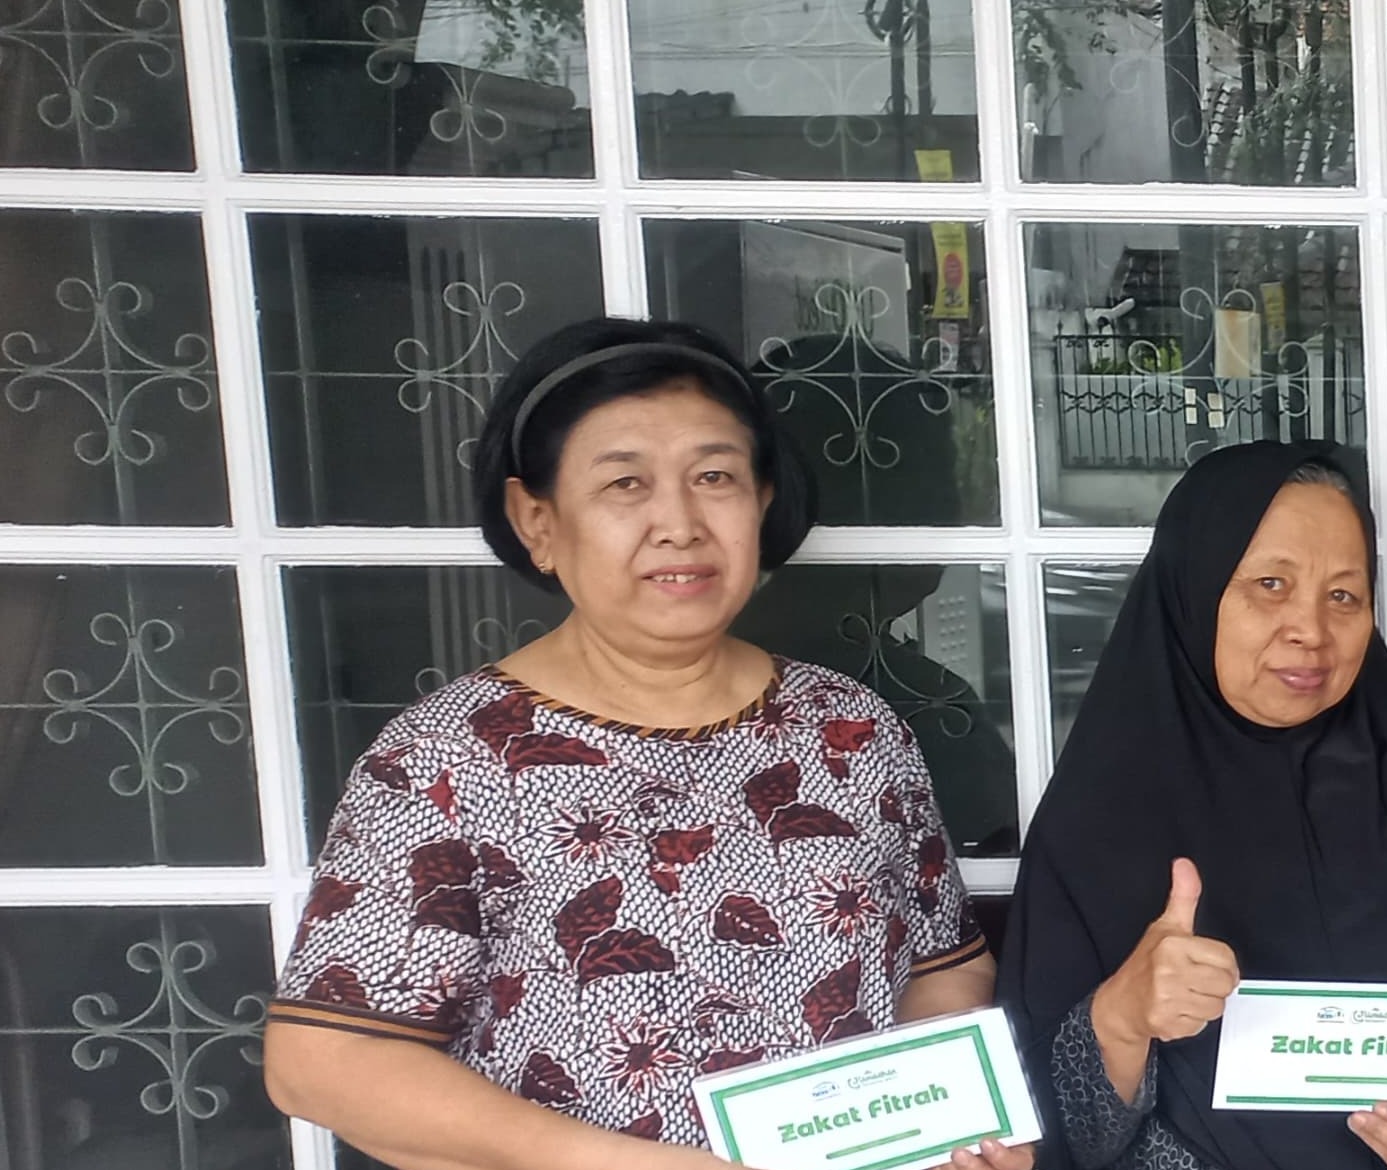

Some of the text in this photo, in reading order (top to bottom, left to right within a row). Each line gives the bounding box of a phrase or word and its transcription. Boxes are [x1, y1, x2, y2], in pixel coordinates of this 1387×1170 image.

[1271, 1035, 1352, 1055] Zakat
[776, 1105, 862, 1144] Zakat
[867, 1083, 949, 1123] Fitrah
